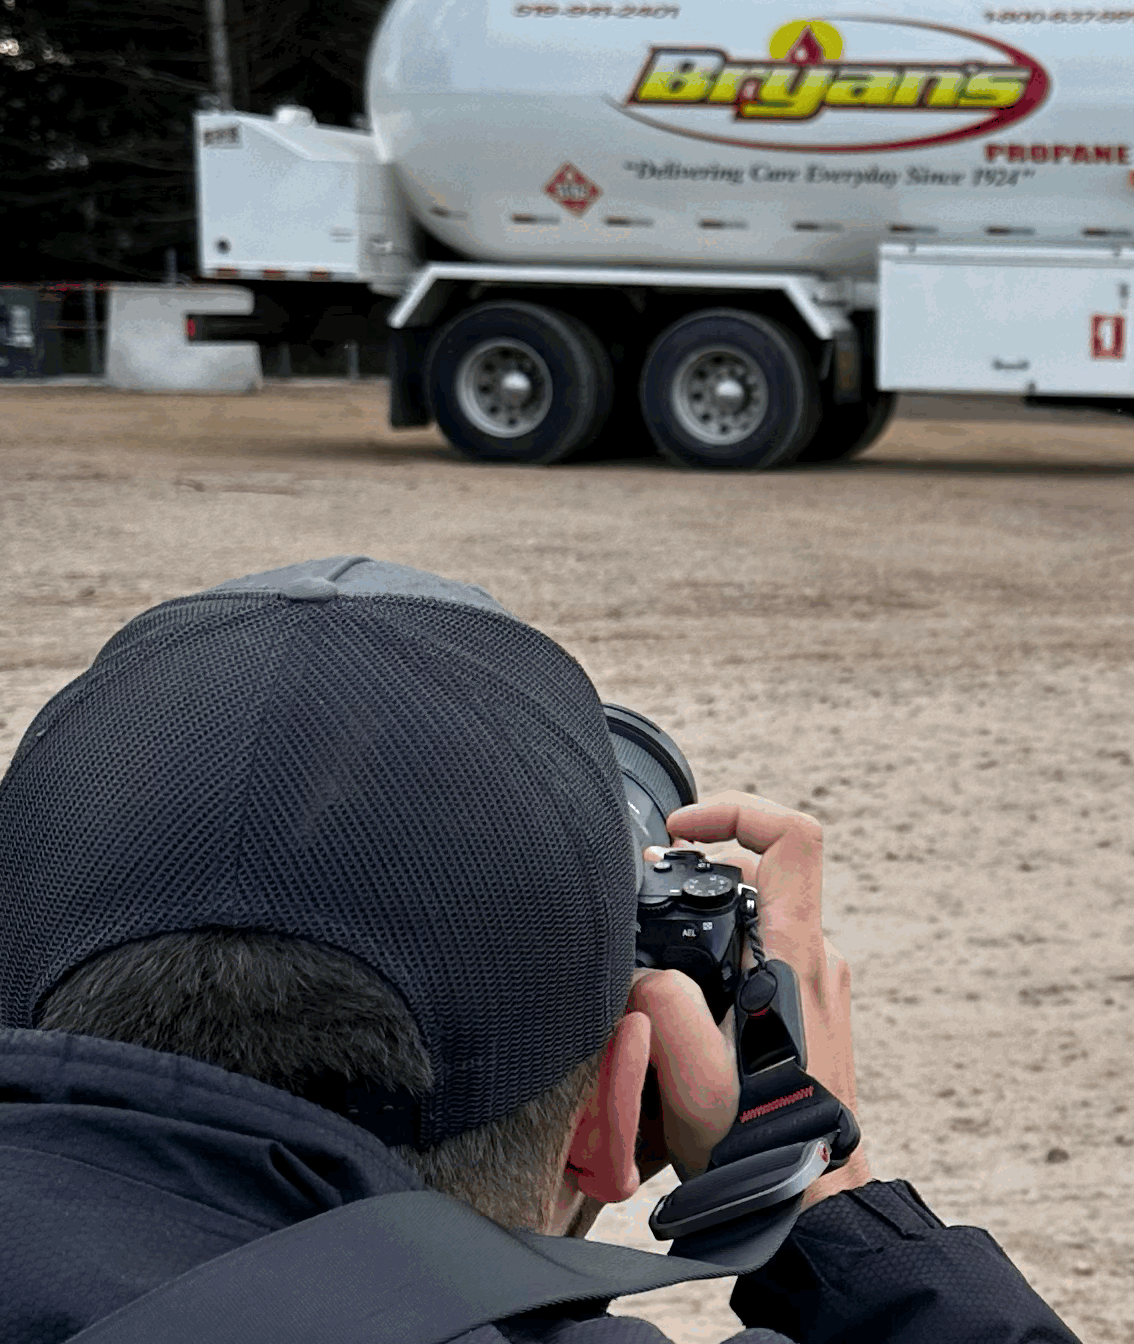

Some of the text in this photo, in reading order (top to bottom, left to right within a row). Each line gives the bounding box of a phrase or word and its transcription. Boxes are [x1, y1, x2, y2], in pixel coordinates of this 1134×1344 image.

[626, 45, 1033, 121] Bryan's
[984, 143, 1132, 165] PROPANE
[750, 160, 799, 183] Care
[805, 162, 898, 188] Everyday
[904, 163, 966, 186] Since
